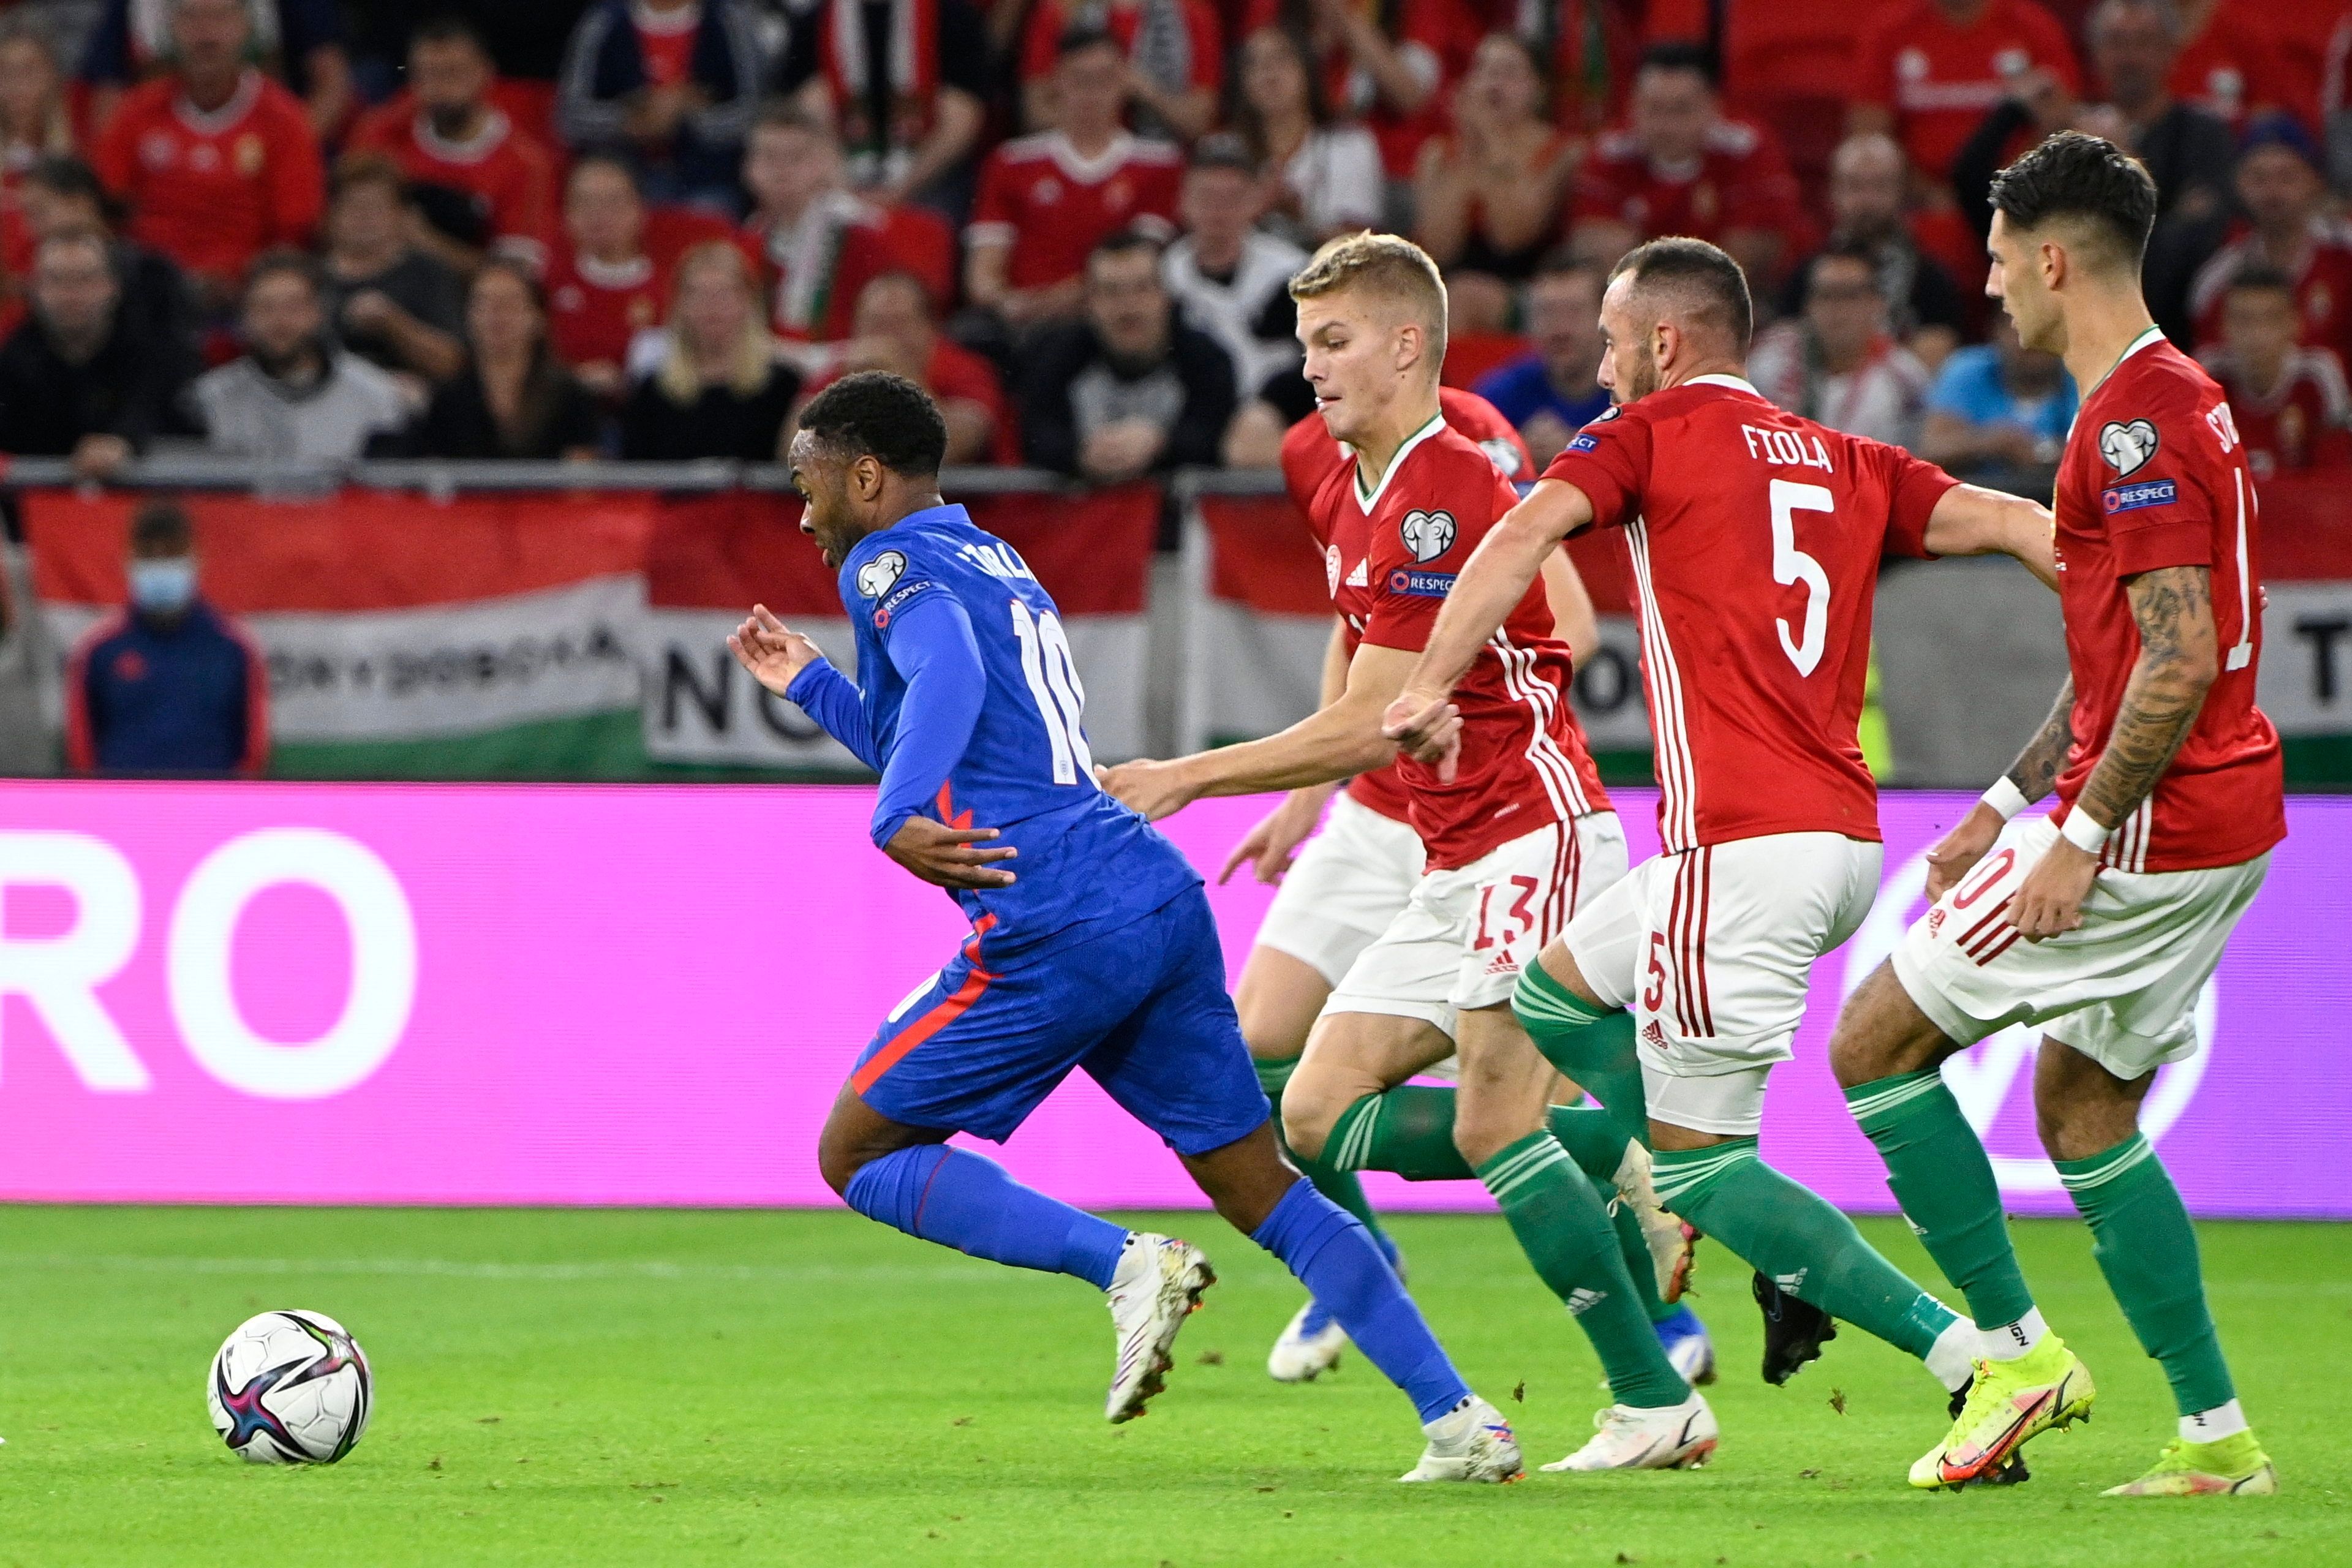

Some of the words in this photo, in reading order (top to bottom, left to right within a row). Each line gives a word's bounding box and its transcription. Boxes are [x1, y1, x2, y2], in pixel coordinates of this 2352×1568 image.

[1741, 424, 1833, 473] FIOLA
[2120, 485, 2174, 504] RESPECT
[884, 581, 930, 611] RESPECT
[1770, 478, 1834, 678] 5
[1010, 598, 1109, 793] 10
[1473, 875, 1538, 951] 13
[0, 827, 416, 1098] RO
[1644, 930, 1666, 1012] 5
